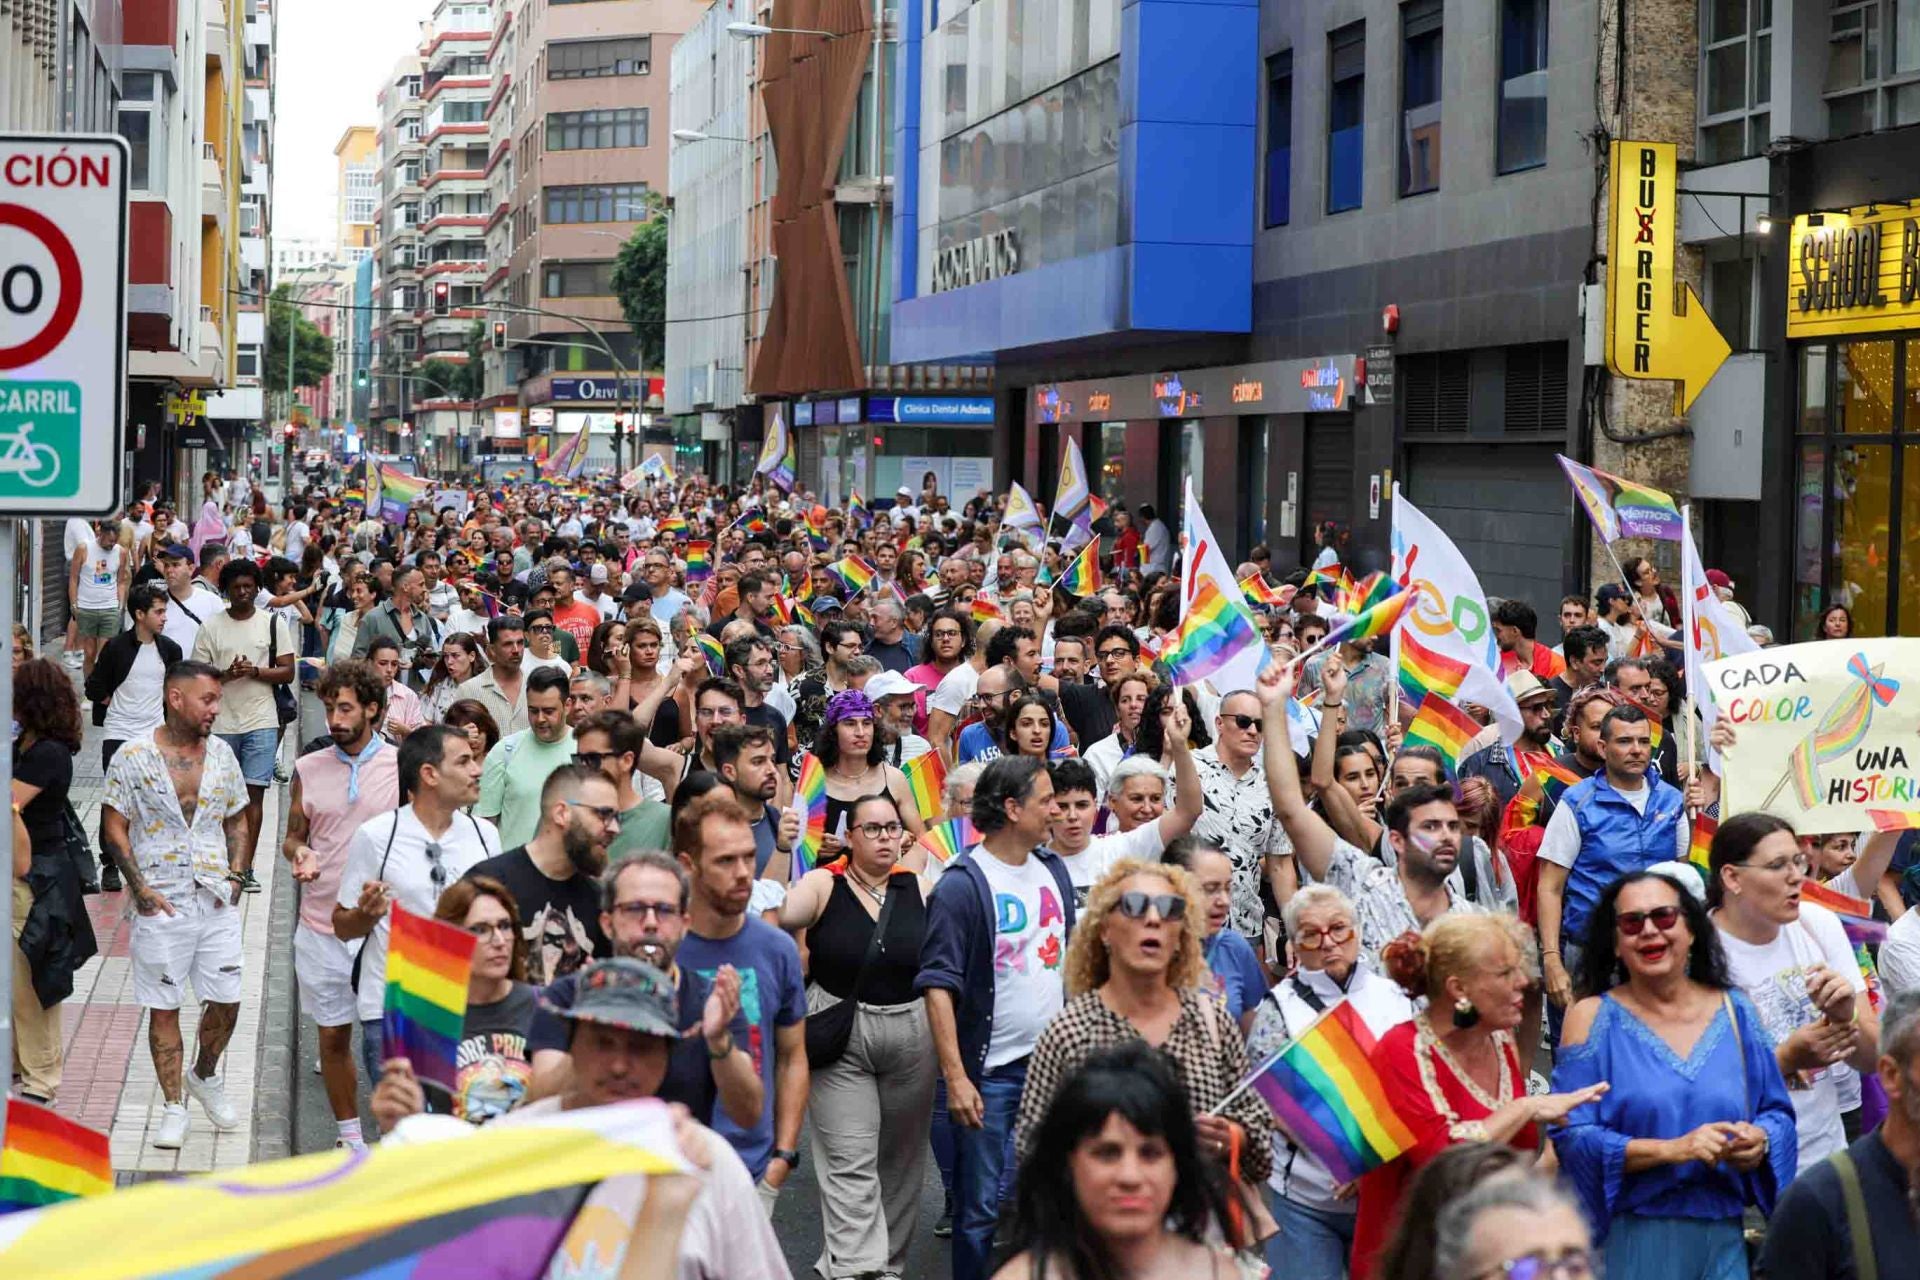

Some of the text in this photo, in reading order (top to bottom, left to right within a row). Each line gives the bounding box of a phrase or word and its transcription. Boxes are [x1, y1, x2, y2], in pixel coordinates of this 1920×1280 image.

[1798, 218, 1920, 313] SCHOOL B
[578, 380, 619, 400] ORIV
[1618, 507, 1672, 521] demos
[1720, 662, 1807, 690] CADA
[1730, 695, 1813, 724] COLOR
[1855, 746, 1909, 772] UNA
[1827, 774, 1920, 805] HISTORI
